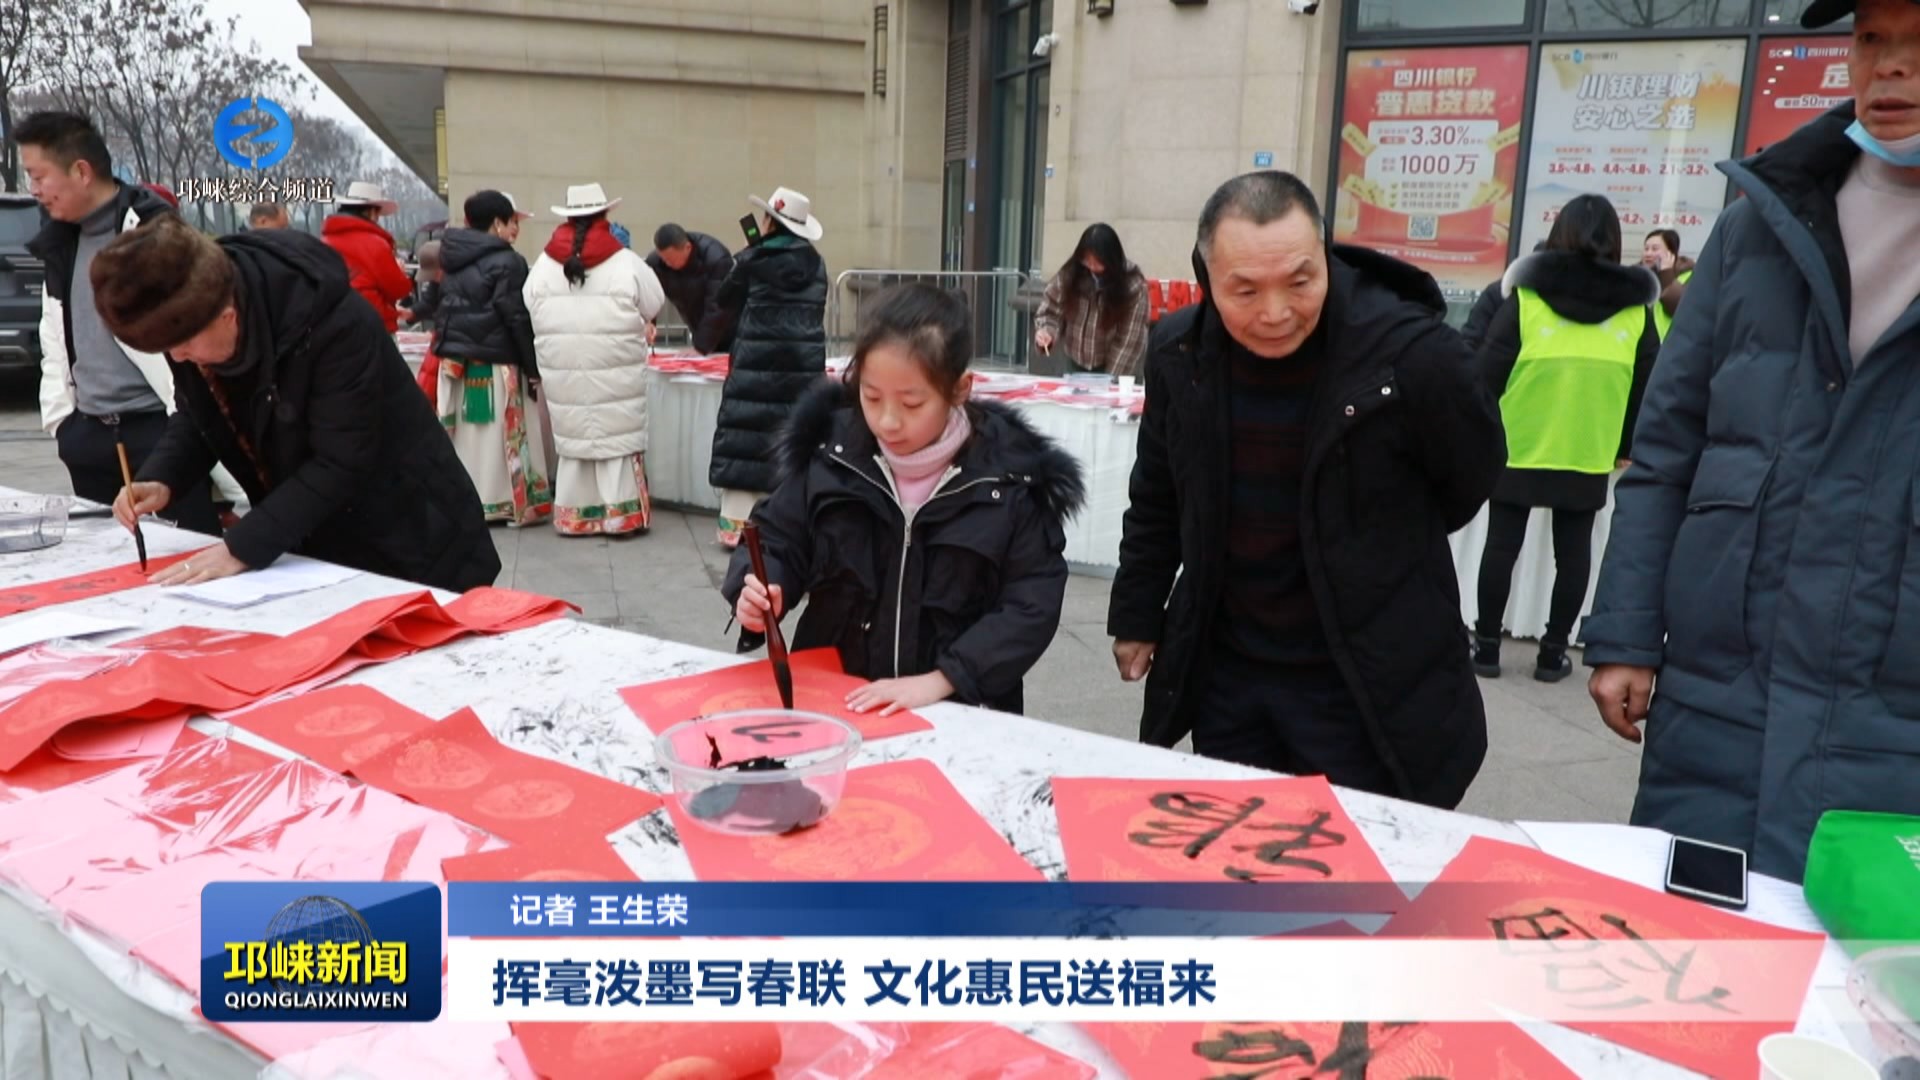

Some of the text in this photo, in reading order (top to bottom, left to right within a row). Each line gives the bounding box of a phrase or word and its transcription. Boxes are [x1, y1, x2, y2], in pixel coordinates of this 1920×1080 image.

[1393, 67, 1477, 87] 四川银行
[1577, 72, 1702, 100] 川银理财
[1376, 88, 1496, 116] 普惠贷款
[1573, 103, 1697, 130] 安心之选
[1411, 125, 1470, 145] 3.30%
